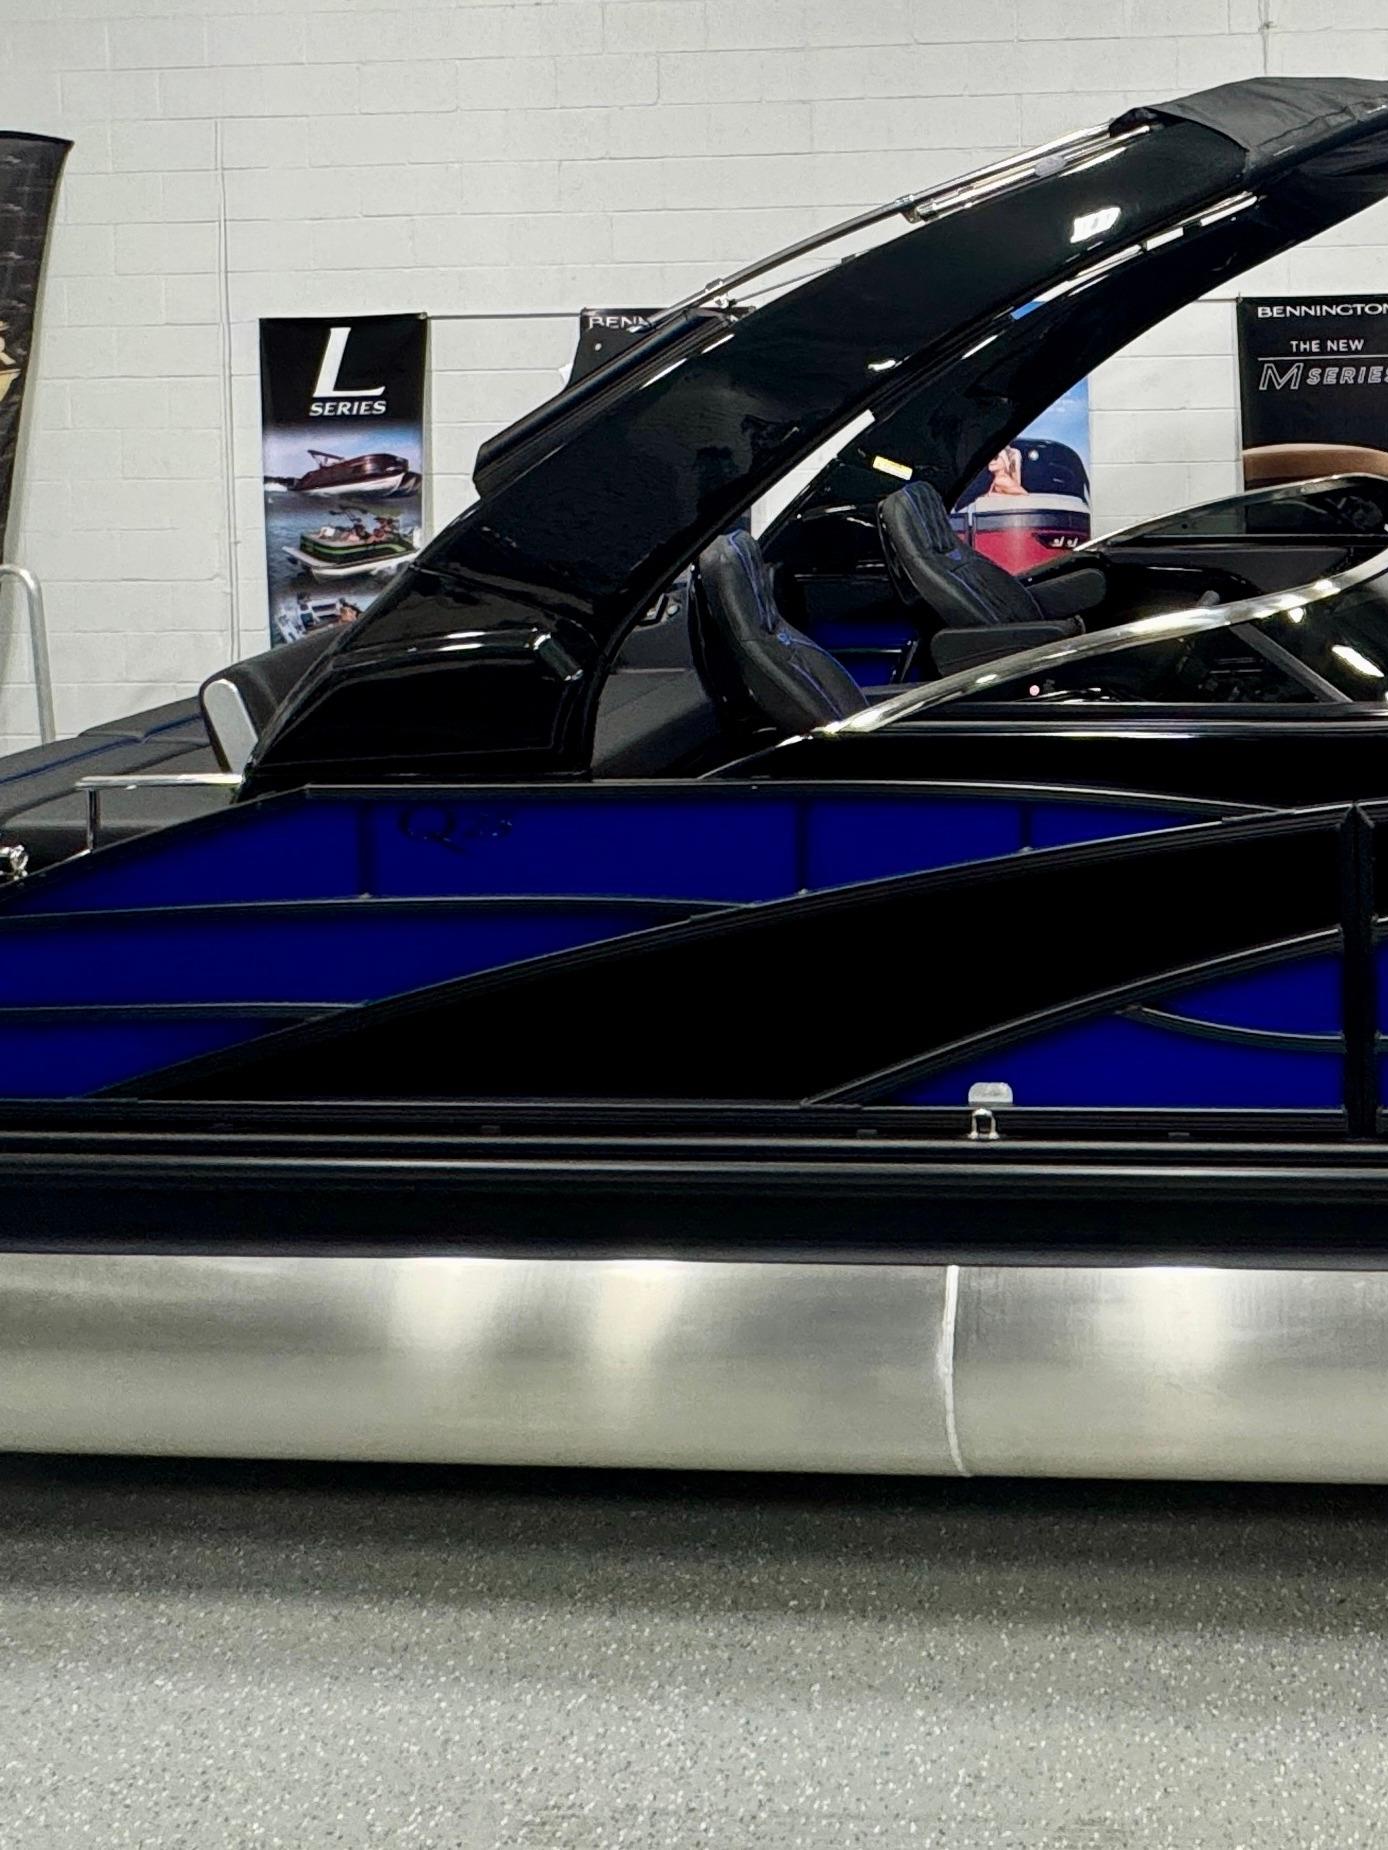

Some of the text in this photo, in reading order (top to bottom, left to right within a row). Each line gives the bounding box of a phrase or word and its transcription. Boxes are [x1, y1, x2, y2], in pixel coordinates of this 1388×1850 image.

[1290, 339, 1364, 353] THE NEW
[313, 327, 386, 398] L
[1258, 362, 1304, 391] M
[309, 400, 387, 416] SERIES
